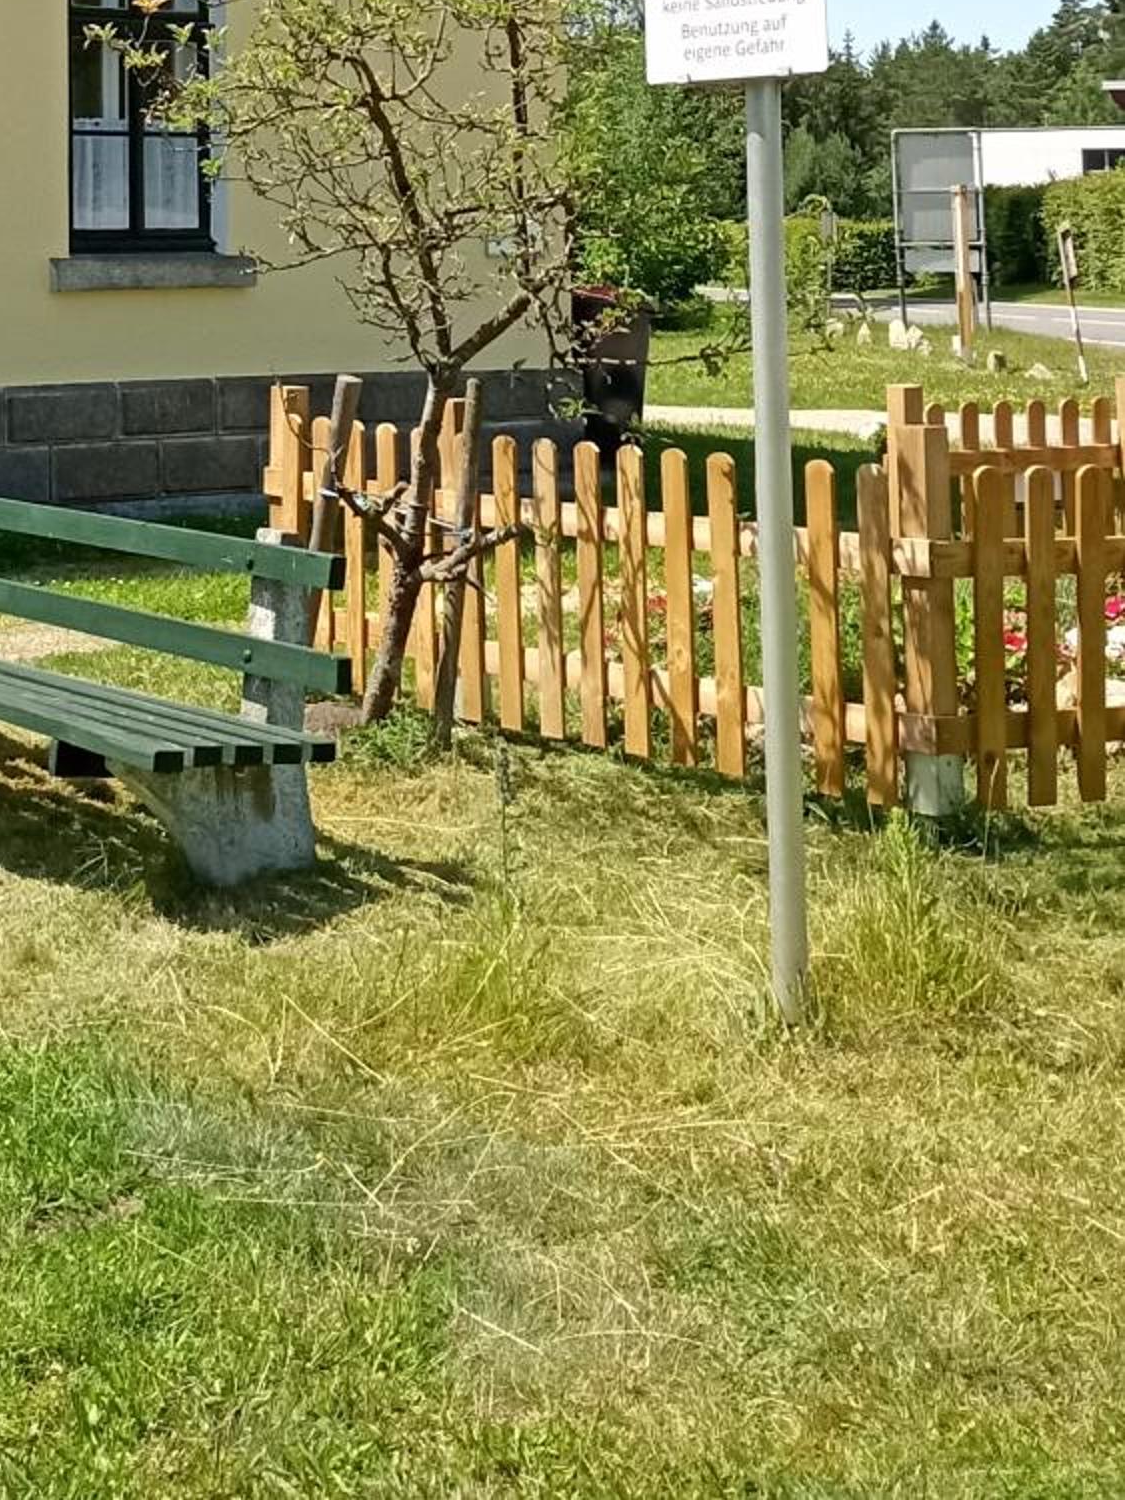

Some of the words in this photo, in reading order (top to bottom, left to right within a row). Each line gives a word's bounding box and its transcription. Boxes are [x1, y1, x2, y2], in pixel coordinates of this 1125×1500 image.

[681, 18, 760, 40] Benutzung
[762, 13, 787, 32] auf
[683, 44, 732, 63] eigene
[734, 38, 785, 57] Gefahr
